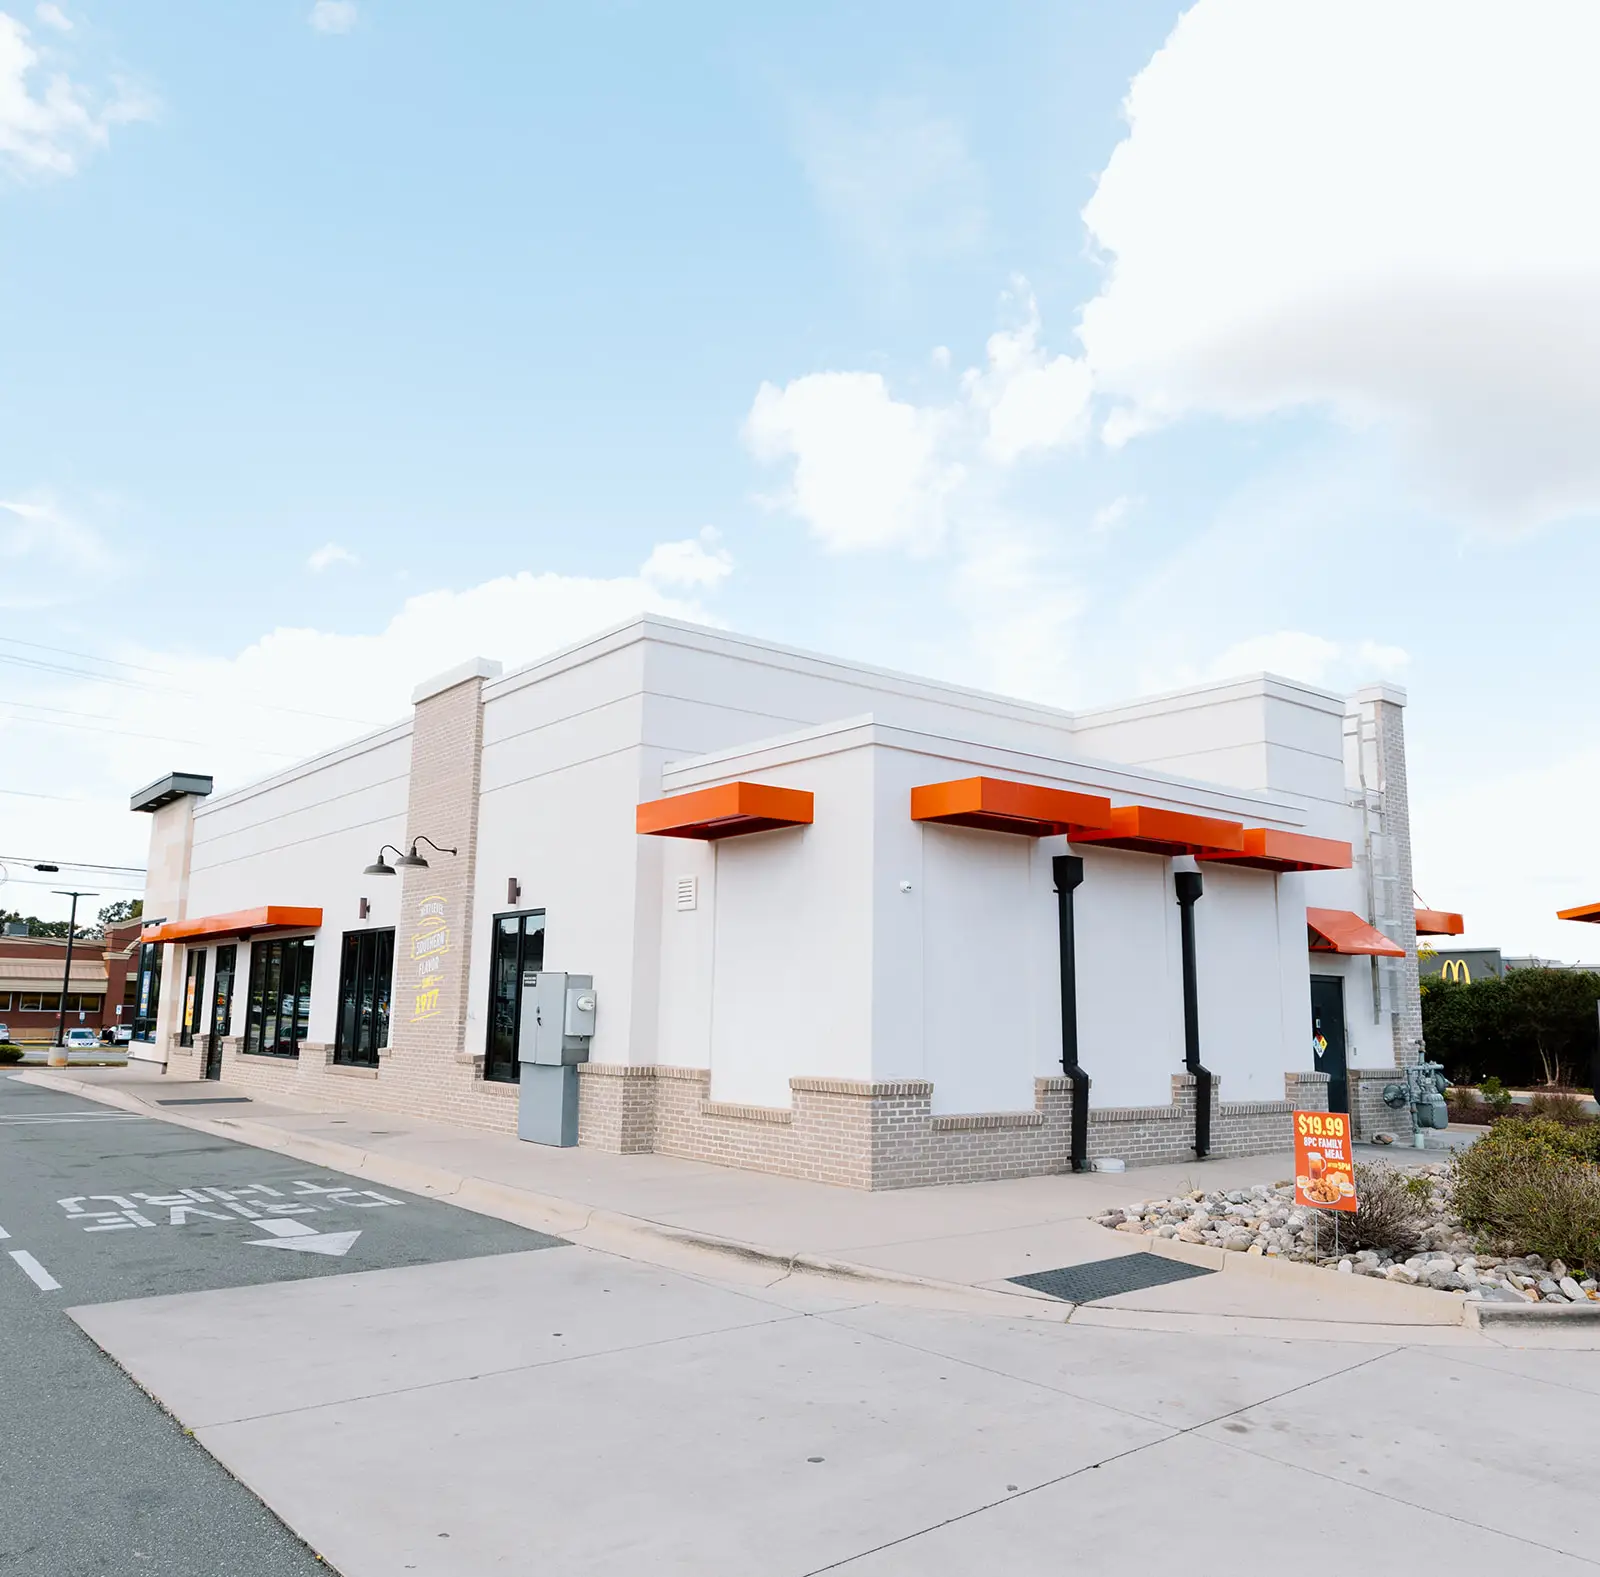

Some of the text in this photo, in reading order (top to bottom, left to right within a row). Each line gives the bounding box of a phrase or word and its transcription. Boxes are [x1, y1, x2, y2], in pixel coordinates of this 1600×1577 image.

[416, 931, 445, 955] SOUTHERN
[419, 956, 440, 976] FLAVOR
[415, 988, 439, 1015] 1977
[1298, 1114, 1344, 1136] $19.99
[1303, 1136, 1343, 1149] 8PC FAMILY
[1324, 1149, 1344, 1160] MEAL
[57, 1180, 352, 1212] THRU
[66, 1191, 405, 1232] DRIVE
